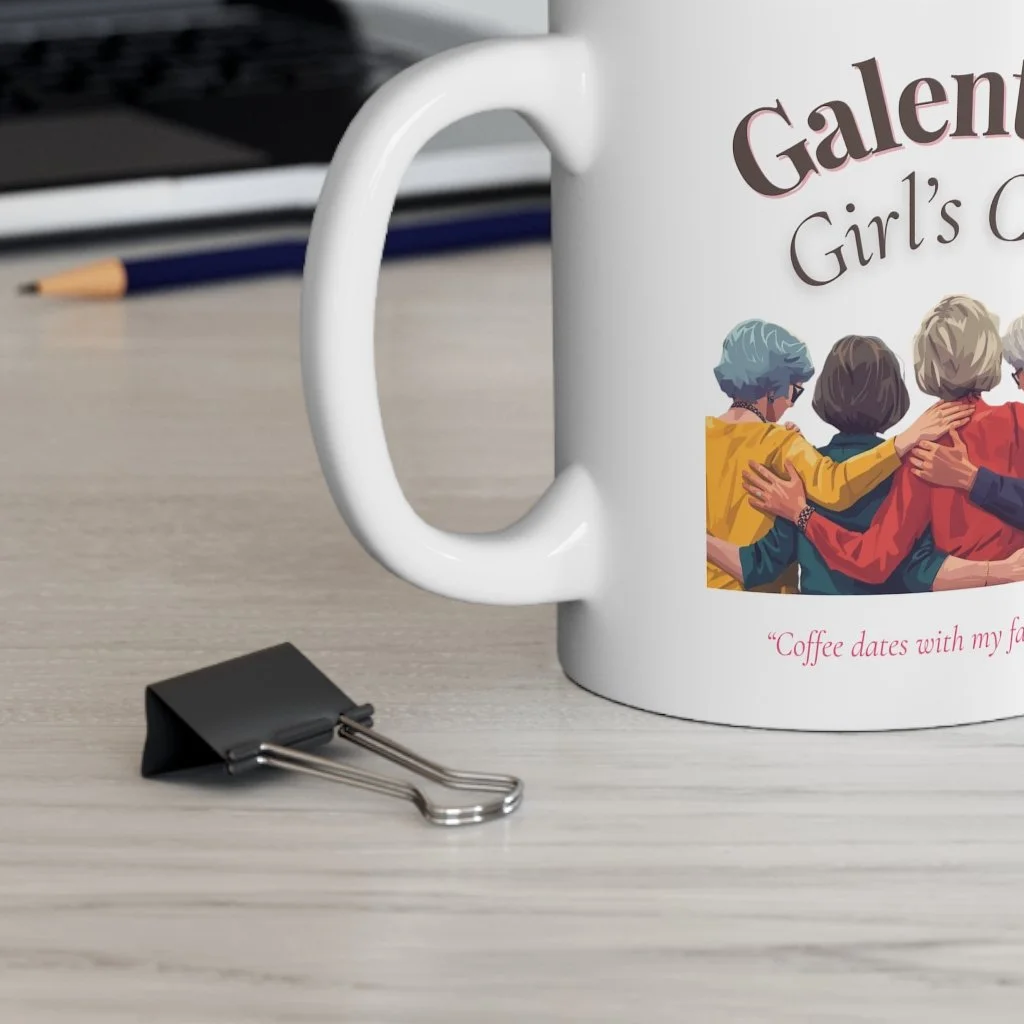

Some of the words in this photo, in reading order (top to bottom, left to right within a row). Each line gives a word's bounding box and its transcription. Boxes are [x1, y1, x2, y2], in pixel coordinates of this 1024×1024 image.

[789, 171, 962, 287] Girl’s
[767, 629, 843, 666] “Coffee
[851, 630, 908, 658] dates
[916, 624, 964, 655] with
[971, 631, 1002, 657] my
